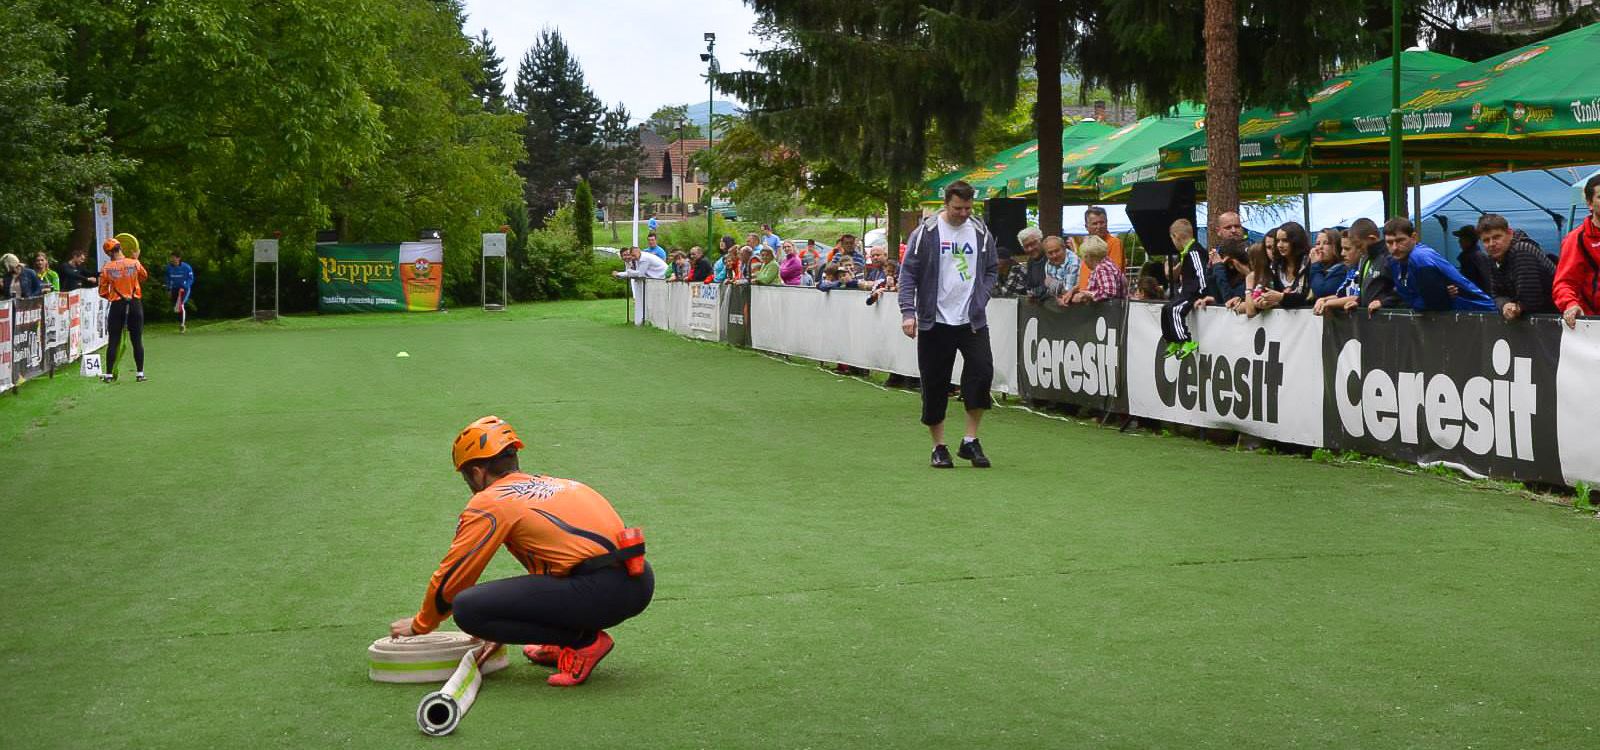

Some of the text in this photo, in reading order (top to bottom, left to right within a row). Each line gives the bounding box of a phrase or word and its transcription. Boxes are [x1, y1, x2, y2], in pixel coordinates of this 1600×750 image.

[319, 257, 395, 284] Popper
[941, 241, 974, 255] FILA
[86, 358, 100, 370] 54
[1023, 316, 1118, 398] Ceresit
[1155, 327, 1283, 423] Ceresit
[1335, 338, 1536, 462] Ceresit
